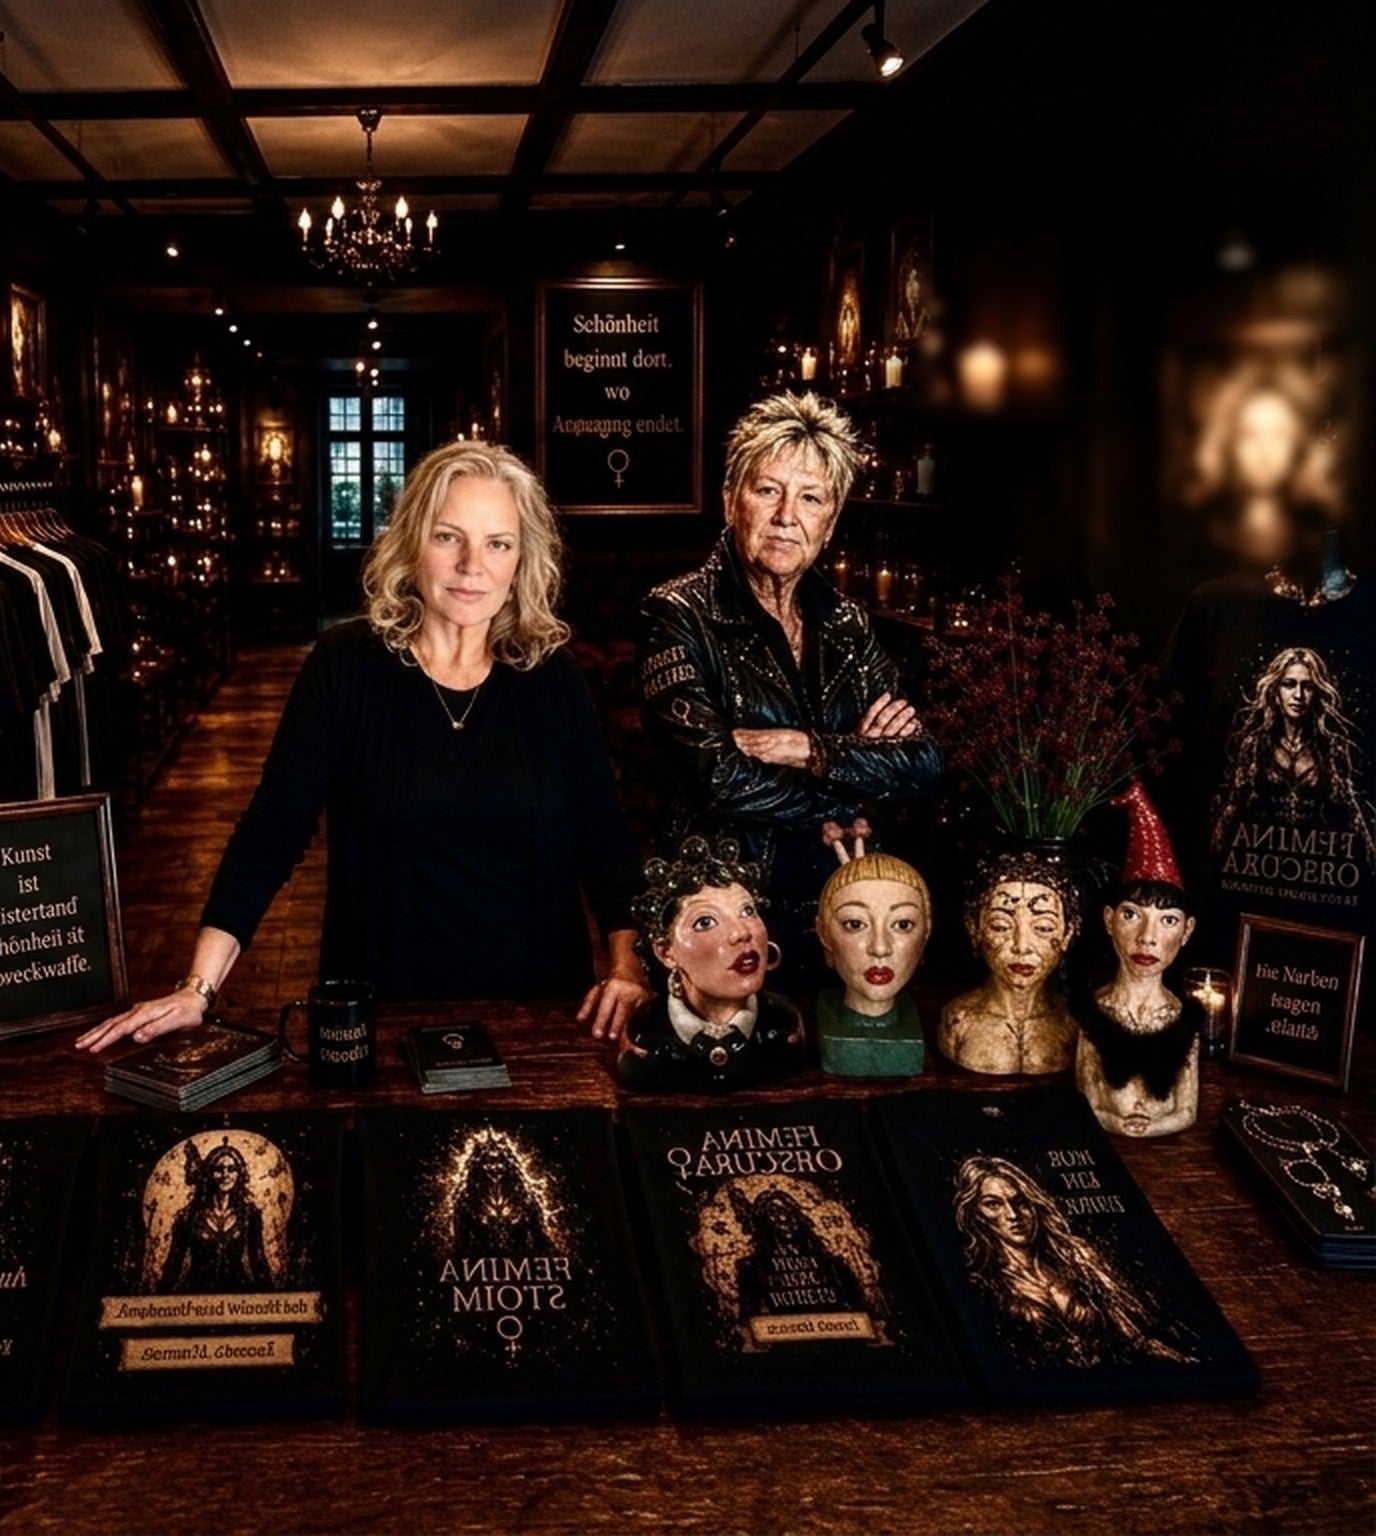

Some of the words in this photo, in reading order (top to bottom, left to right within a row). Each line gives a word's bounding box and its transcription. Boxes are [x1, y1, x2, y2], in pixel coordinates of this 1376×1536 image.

[563, 347, 628, 373] beginnt
[604, 385, 631, 401] wo
[0, 843, 52, 867] Kunst
[17, 874, 40, 894] ist
